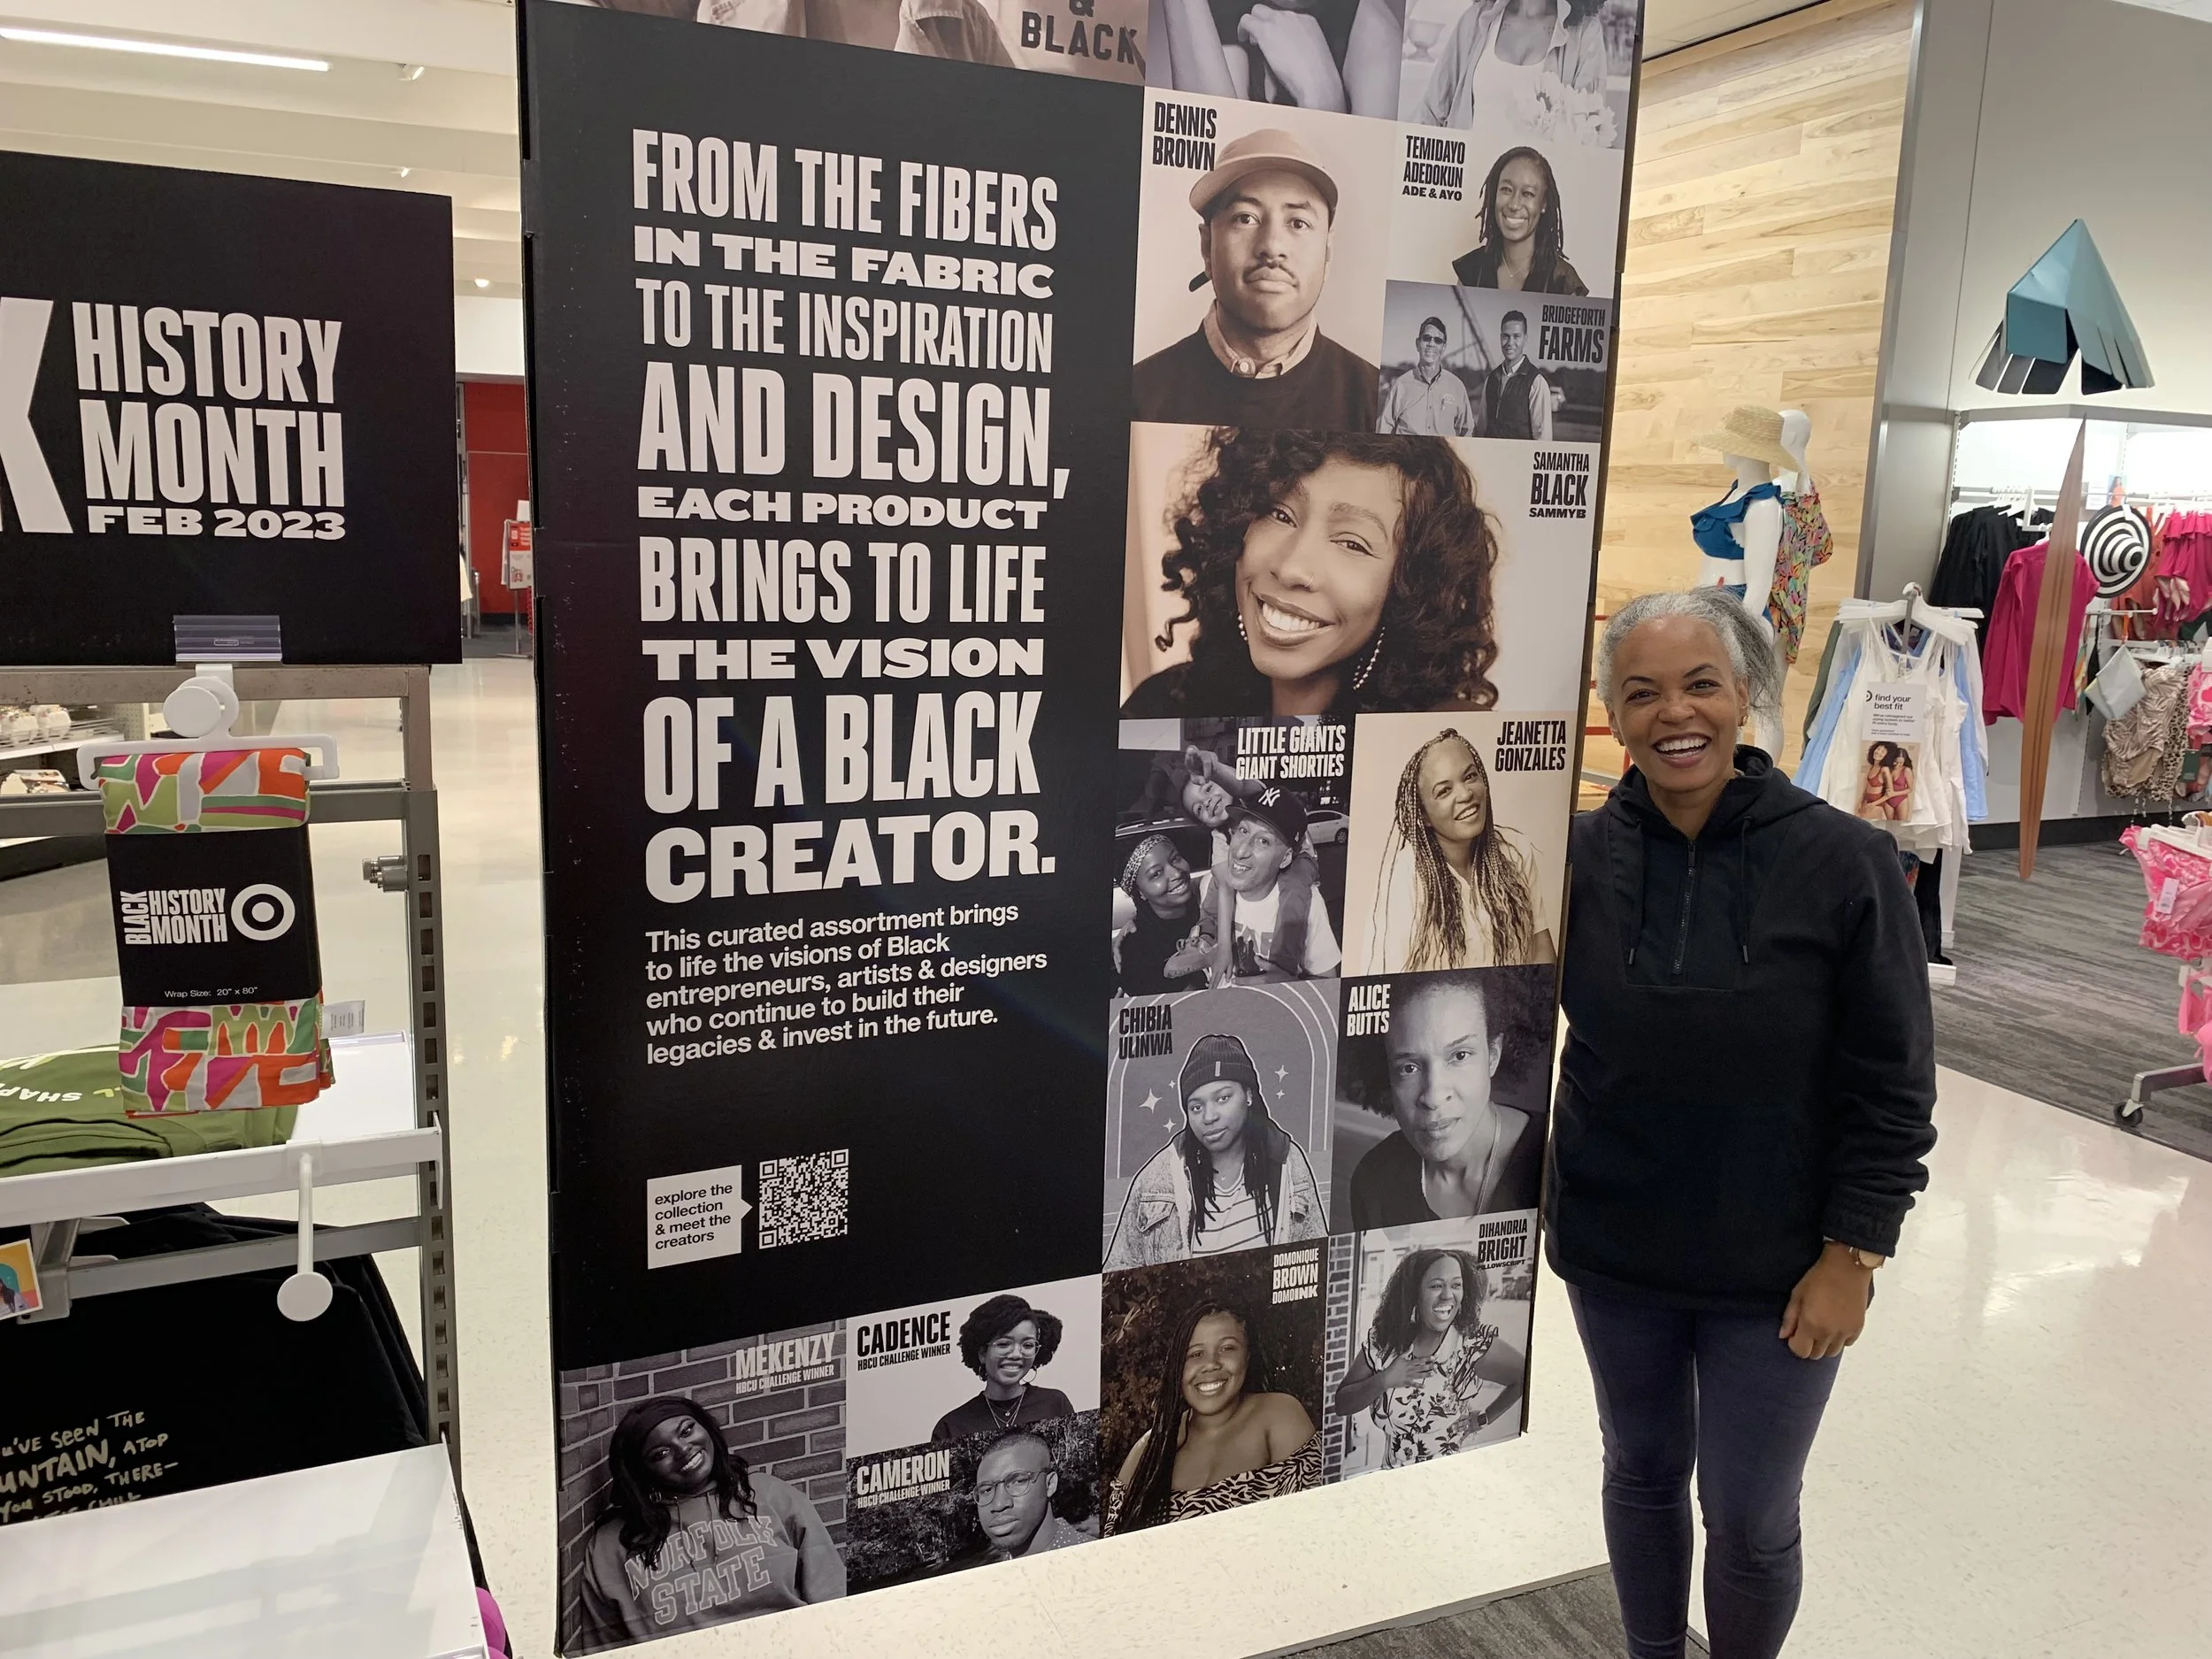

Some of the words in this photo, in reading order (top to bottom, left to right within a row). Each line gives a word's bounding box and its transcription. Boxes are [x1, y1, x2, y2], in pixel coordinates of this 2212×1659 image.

[1021, 11, 1138, 65] BLACK
[1154, 101, 1217, 139] DENNIS
[1152, 135, 1216, 172] BROWN
[1406, 134, 1465, 165] TEMIDAYO
[632, 128, 778, 222] FROM
[795, 148, 883, 234] THE
[900, 160, 1057, 251] FIBERS
[1403, 161, 1463, 188] ADEDOKUN
[1402, 185, 1426, 197] ADE
[1428, 188, 1438, 199] &
[1439, 189, 1463, 201] AYO
[634, 225, 700, 267] IN
[711, 233, 836, 279] THE
[851, 246, 1054, 299] FABRIC
[635, 278, 691, 348] TO
[704, 283, 785, 354] THE
[799, 291, 1053, 373] INSPIRATION
[1541, 304, 1606, 326] BRIDGEFORTH
[72, 302, 342, 404] HISTORY
[1539, 325, 1605, 364] FARMS
[637, 360, 786, 475] AND
[812, 372, 1071, 500] DESIGN,
[79, 398, 345, 507] MONTH
[1533, 451, 1589, 472] SAMANTHA
[1530, 472, 1589, 506] BLACK
[88, 505, 203, 535] FEB
[213, 508, 346, 541] 2023
[637, 486, 791, 522] EACH
[802, 492, 1048, 530] PRODUCT
[1529, 507, 1586, 518] SAMMYB
[639, 536, 851, 624] BRINGS
[868, 541, 932, 623] TO
[949, 544, 1047, 623] LIFE
[642, 639, 795, 681] THE
[805, 637, 1044, 679] VISION
[1237, 726, 1286, 755] LITTLE
[1289, 725, 1347, 754] GIANTS
[1496, 720, 1566, 746] JEANETTA
[643, 696, 734, 814] OF
[754, 695, 804, 808] A
[825, 690, 1043, 804] BLACK
[1235, 756, 1278, 780] GIANT
[1279, 753, 1345, 779] SHORTIES
[1494, 747, 1566, 772] GONZALES
[645, 810, 1056, 904] CREATOR.
[148, 887, 226, 916] HISTORY
[119, 890, 152, 945] BLACK
[150, 913, 228, 944] MONTH
[645, 929, 701, 953] This
[707, 918, 803, 948] curated
[810, 908, 945, 938] assortment
[949, 903, 1018, 926] brings
[645, 961, 672, 981] to
[680, 956, 717, 978] life
[723, 951, 764, 972] the
[770, 944, 852, 968] visions
[857, 938, 881, 959] of
[887, 933, 950, 957] Black
[164, 990, 188, 999] Wrap
[646, 973, 832, 1009] entrepreneurs,
[837, 964, 912, 988] artists
[918, 959, 935, 980] &
[941, 953, 1048, 978] designers
[646, 1013, 702, 1037] who
[709, 1002, 816, 1030] continue
[821, 996, 846, 1017] to
[852, 987, 907, 1013] build
[912, 982, 965, 1006] their
[1348, 984, 1391, 1012] ALICE
[1118, 1004, 1172, 1035] CHIBIA
[1346, 1010, 1390, 1037] BUTTS
[647, 1034, 752, 1066] legacies
[757, 1029, 777, 1050] &
[782, 1020, 853, 1048] invest
[858, 1018, 879, 1039] in
[884, 1014, 921, 1035] the
[926, 1008, 998, 1031] future.
[1118, 1032, 1173, 1060] ULINWA
[0, 1082, 82, 1102] SHAP
[655, 1190, 707, 1205] explore
[710, 1184, 733, 1196] the
[655, 1202, 723, 1220] collection
[655, 1224, 665, 1235] &
[669, 1217, 705, 1233] meet
[709, 1214, 731, 1226] the
[655, 1232, 715, 1250] creators
[1479, 1218, 1527, 1239] DIHANDRIA
[1273, 1248, 1319, 1268] DOMONIQUE
[1478, 1235, 1528, 1263] BRIGHT
[1272, 1263, 1318, 1290] BROWN
[1271, 1284, 1318, 1305] DOMOINK
[856, 1310, 951, 1357] CADENCE
[735, 1331, 835, 1381] MEKENZY
[857, 1356, 878, 1371] HBCU
[879, 1349, 919, 1368] CHALLENGE
[920, 1343, 951, 1358] WINNER
[736, 1379, 757, 1394] HBCU
[758, 1371, 802, 1390] CHALLENGE
[803, 1364, 834, 1381] WINNER
[105, 1410, 145, 1428] THE
[856, 1448, 950, 1496] CAMERON
[857, 1493, 878, 1509] HBCU
[879, 1486, 920, 1505] CHALLENGE
[921, 1479, 950, 1494] WINNER
[624, 1515, 778, 1601] NORFOLK
[650, 1546, 772, 1625] STATE
